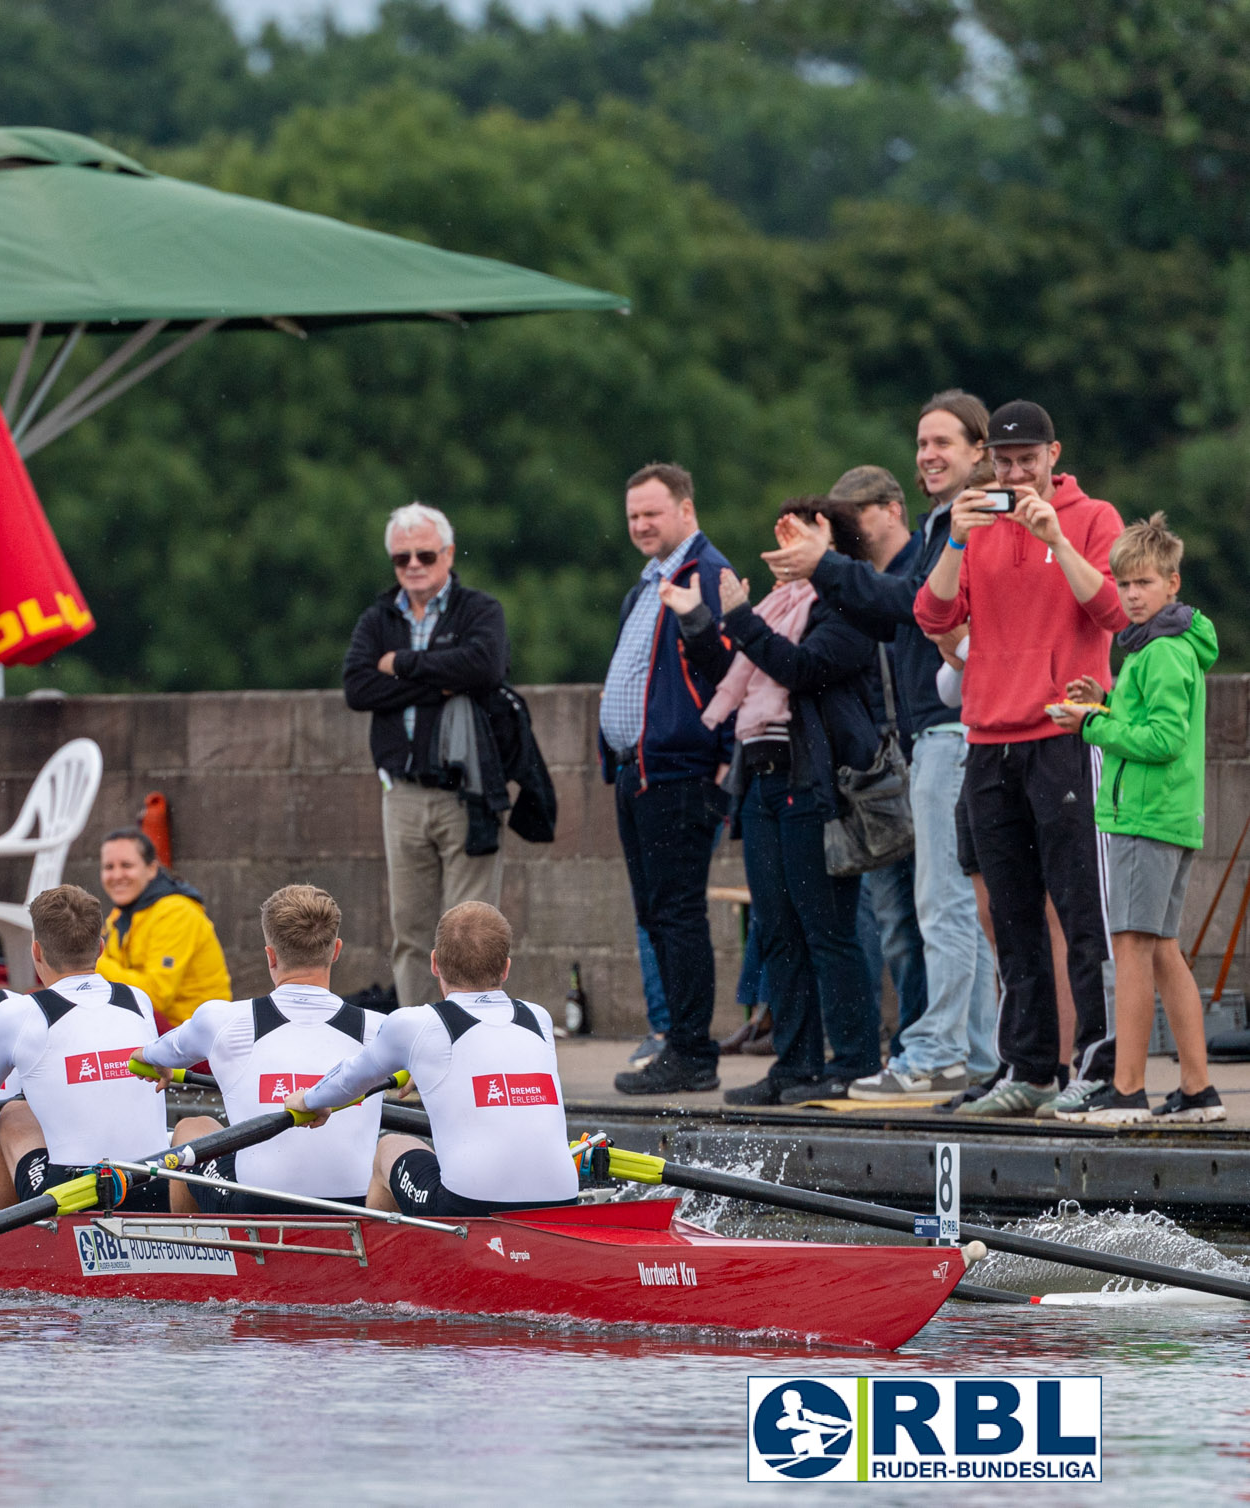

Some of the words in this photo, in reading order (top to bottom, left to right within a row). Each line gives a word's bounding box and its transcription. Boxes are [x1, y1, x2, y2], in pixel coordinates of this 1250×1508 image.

[510, 1086, 541, 1095] BREMEN
[512, 1095, 547, 1104] ERLEBEN!
[939, 1146, 953, 1213] 8
[93, 1231, 129, 1261] RBL
[638, 1262, 680, 1286] Nordwest
[679, 1262, 698, 1286] Kru
